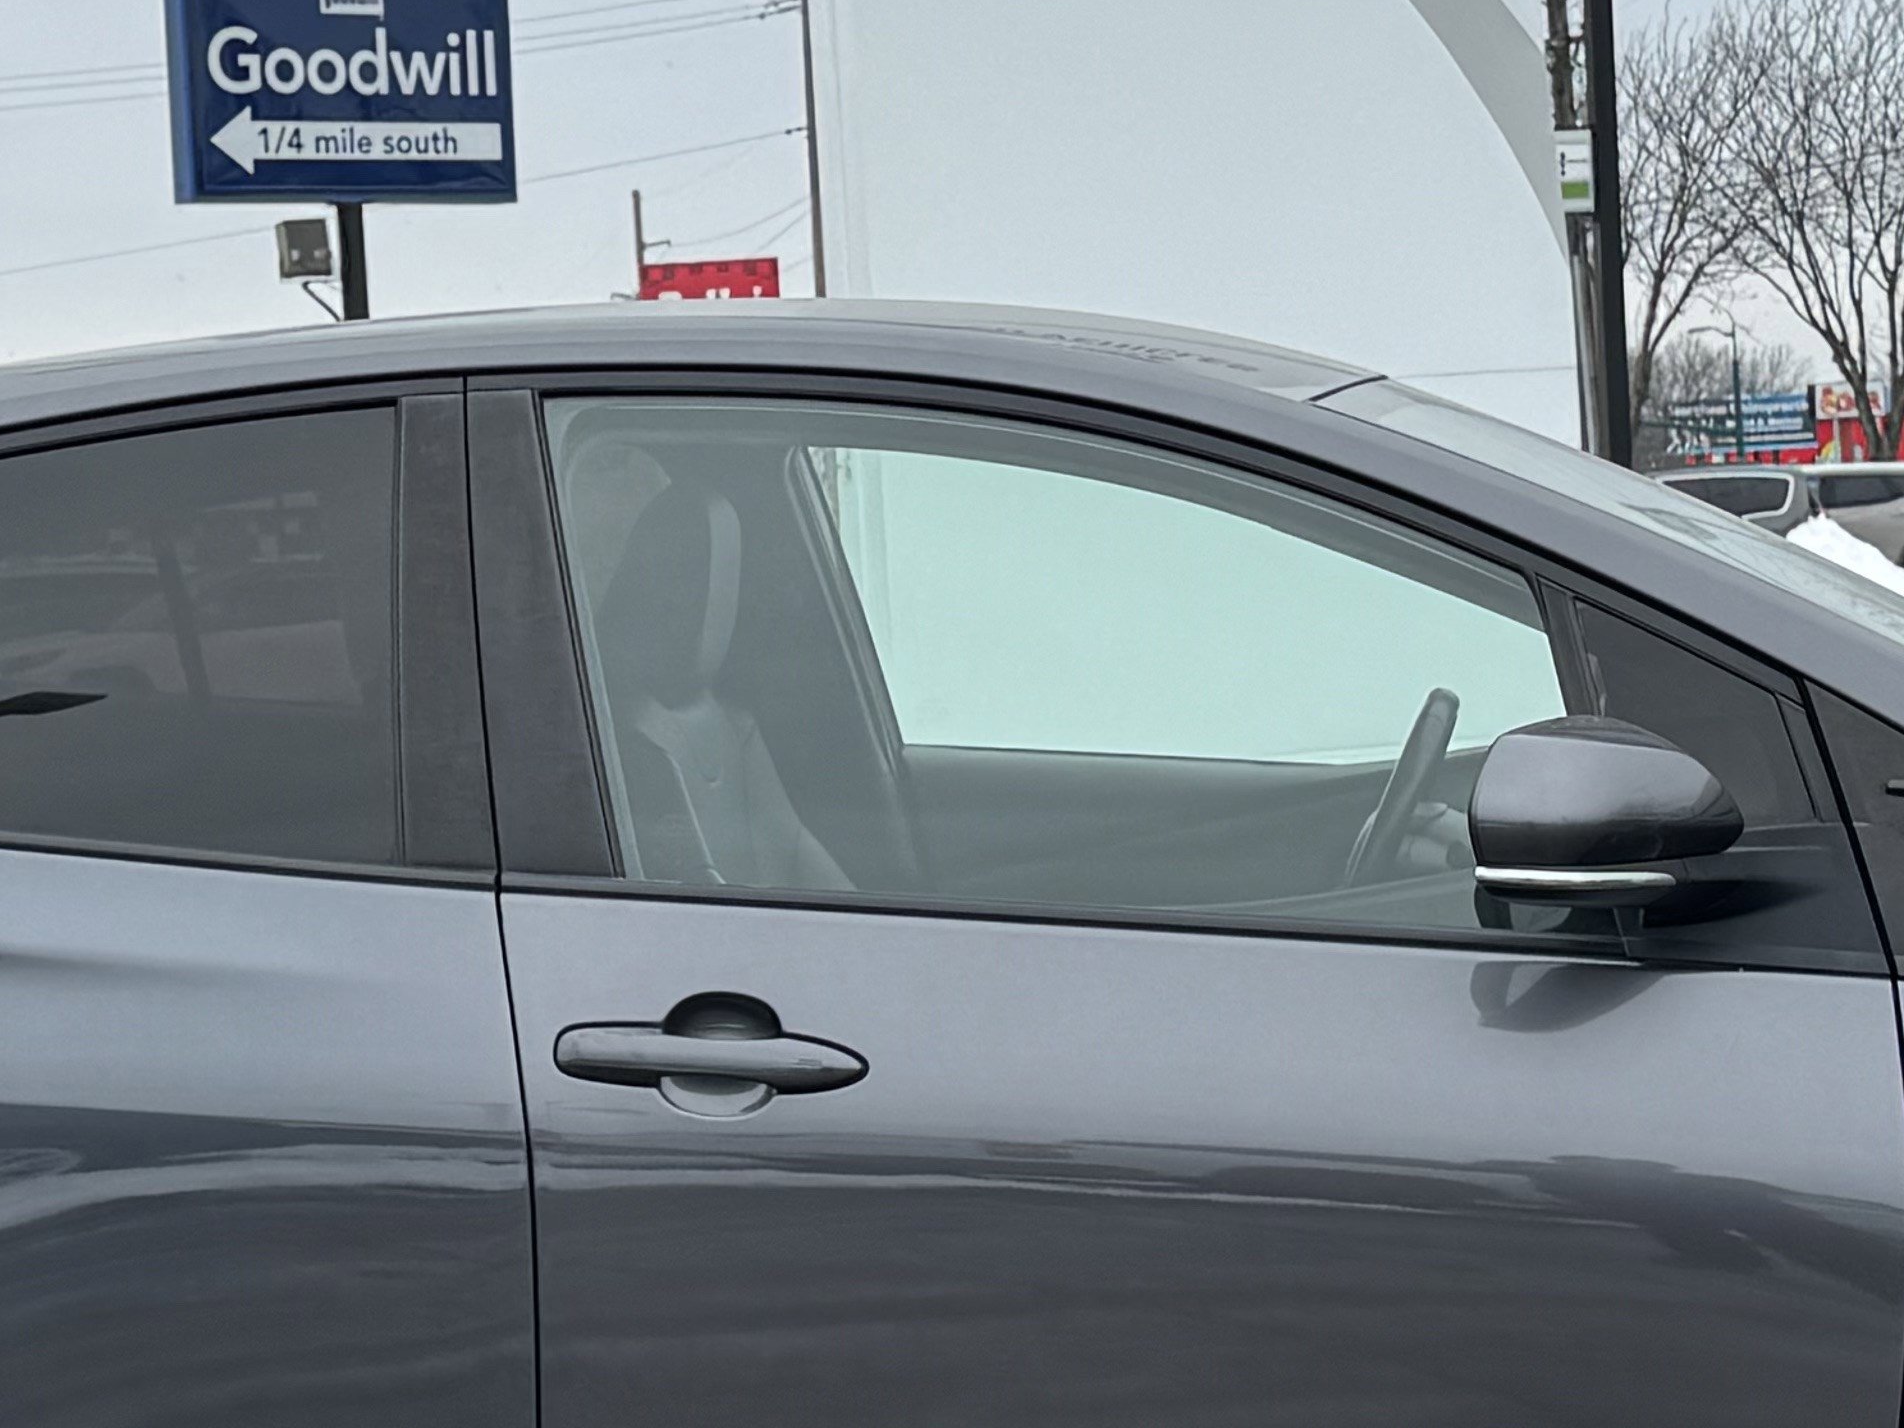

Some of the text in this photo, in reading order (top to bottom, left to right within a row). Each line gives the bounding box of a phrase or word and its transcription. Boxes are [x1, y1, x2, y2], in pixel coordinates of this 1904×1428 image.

[207, 26, 497, 97] Goodwill
[257, 128, 457, 155] 1/4 mile south
